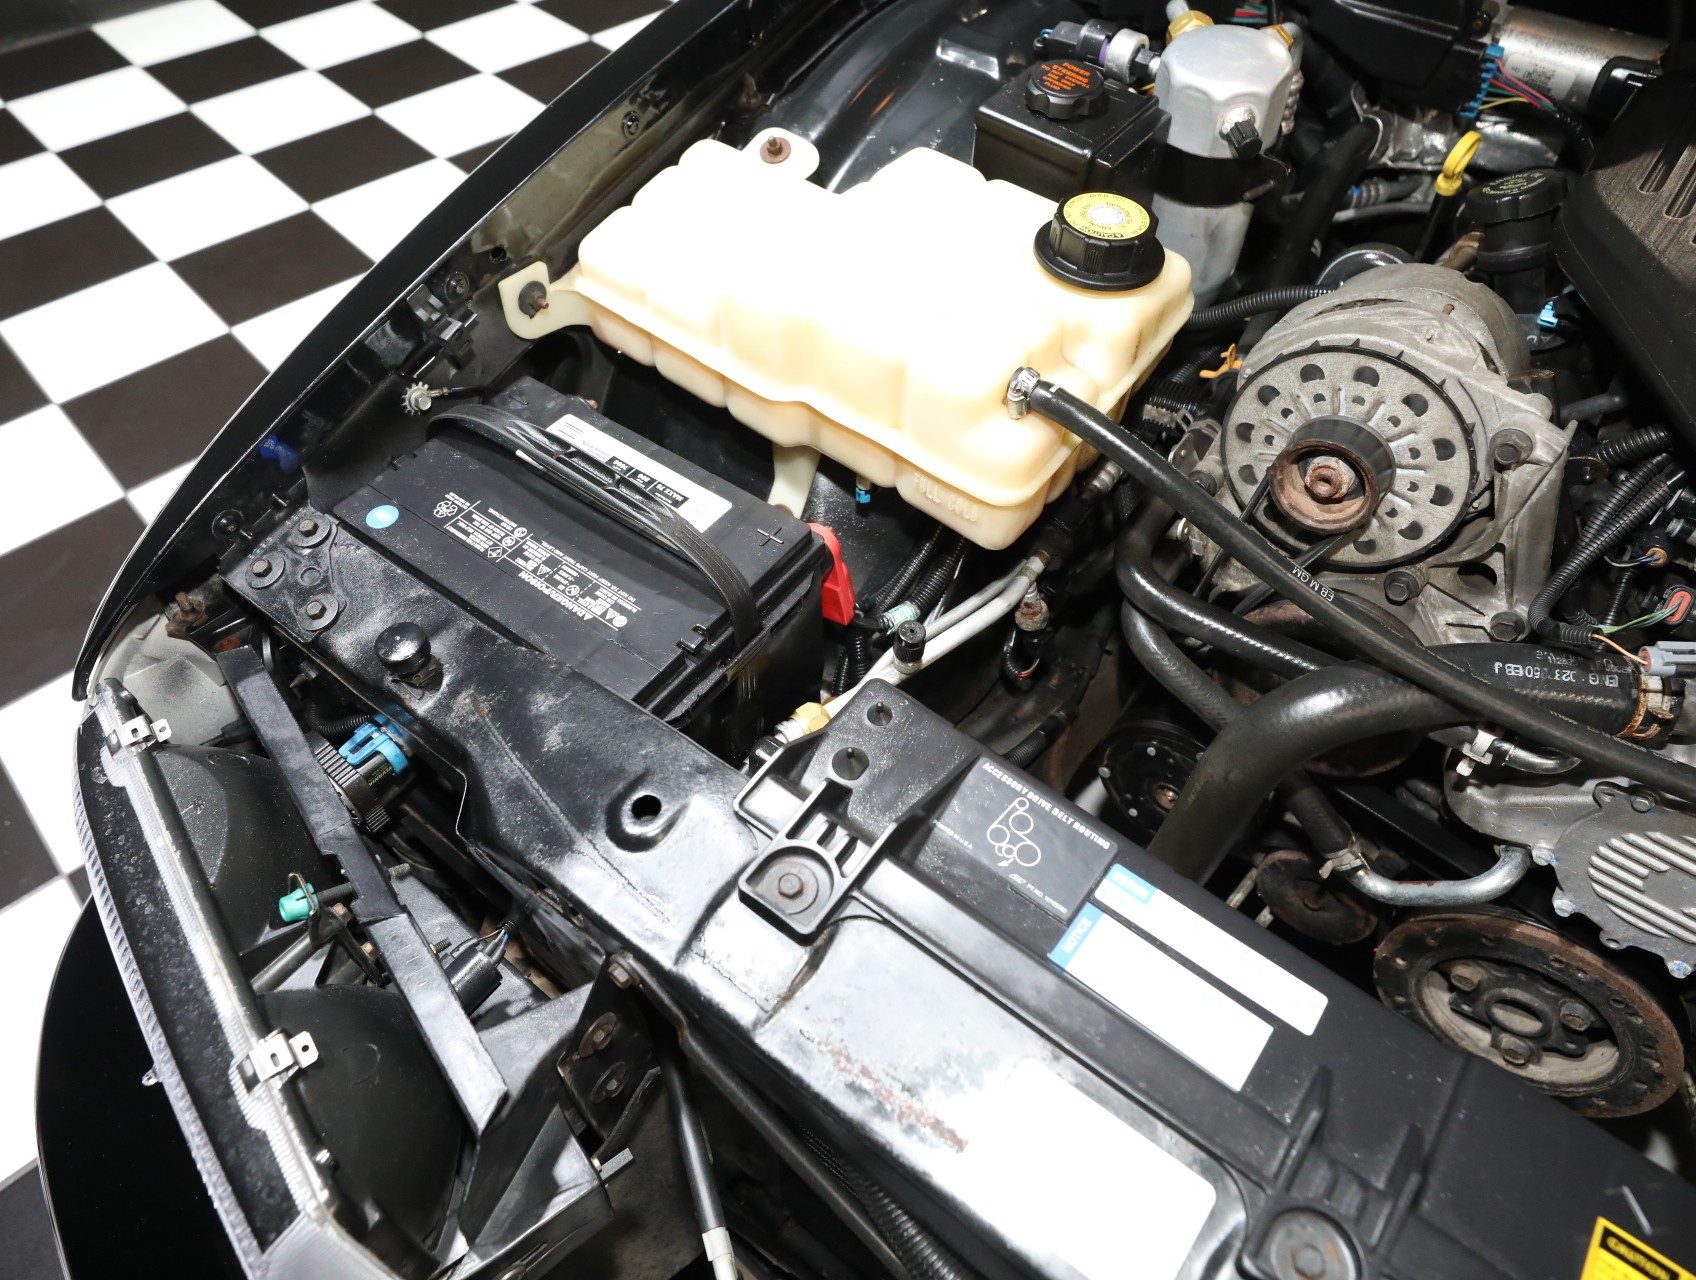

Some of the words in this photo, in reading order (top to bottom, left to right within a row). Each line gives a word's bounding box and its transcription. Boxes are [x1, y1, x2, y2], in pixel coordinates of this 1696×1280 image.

[1051, 64, 1089, 83] STEERING
[1062, 61, 1091, 76] POWER
[1043, 81, 1060, 90] FLUID
[1060, 78, 1076, 86] ONLY
[1064, 75, 1090, 88] OVERFILL
[553, 548, 564, 556] AND
[562, 554, 576, 564] TIGHT
[575, 562, 588, 571] CAPS
[586, 570, 599, 579] VENT
[1290, 565, 1310, 583] GM
[597, 576, 611, 586] KEEP
[1308, 579, 1320, 591] M
[518, 570, 586, 617] DANGER/POISON
[616, 587, 628, 596] NOT
[1318, 586, 1335, 602] EB
[981, 761, 1029, 796] ACCESSORY
[1025, 790, 1053, 812] DRIVE
[1050, 806, 1074, 826] BELT
[1071, 820, 1111, 850] ROUTING
[1060, 914, 1093, 955] NOTICE
